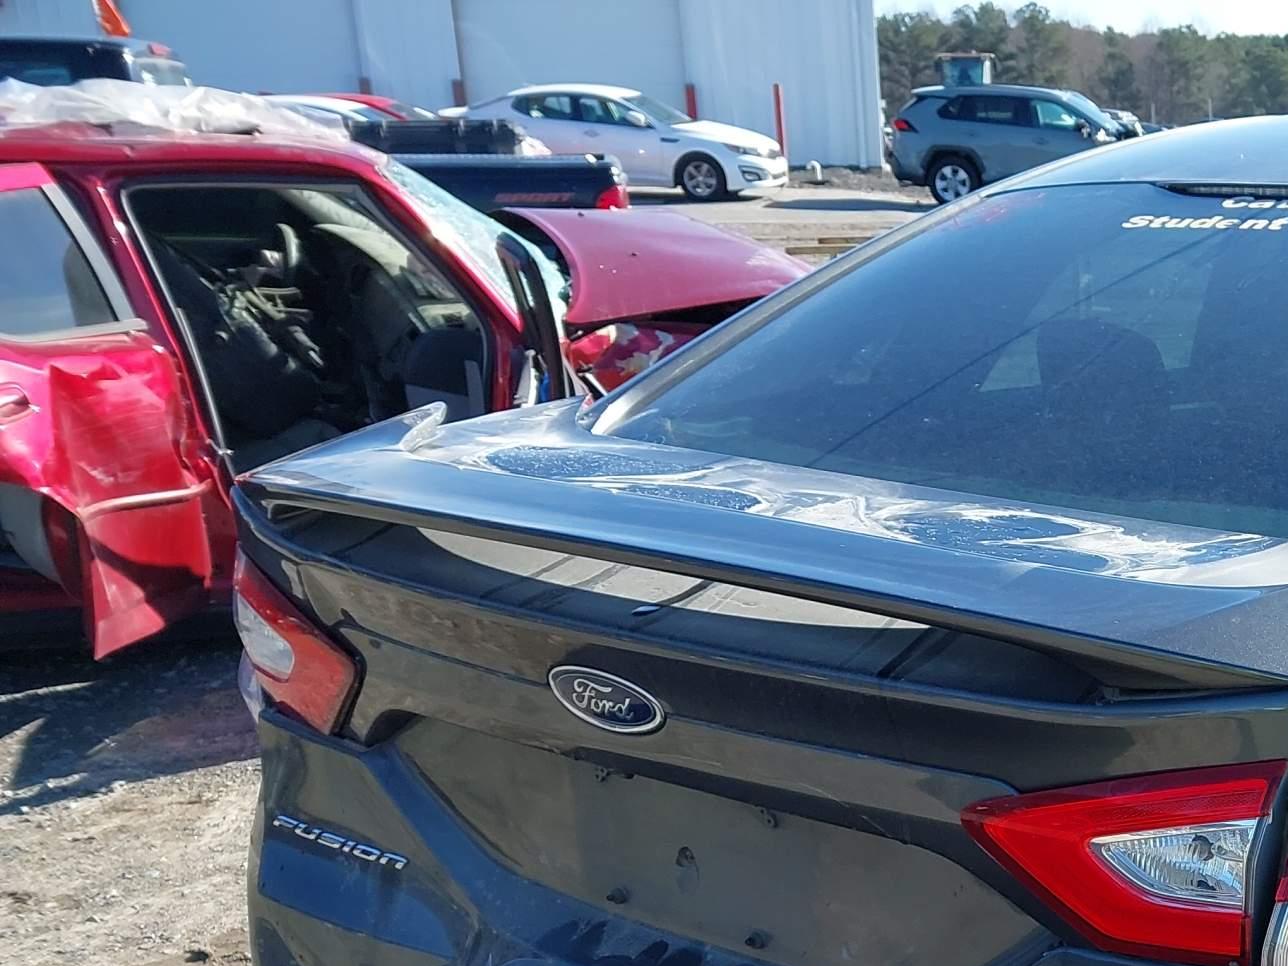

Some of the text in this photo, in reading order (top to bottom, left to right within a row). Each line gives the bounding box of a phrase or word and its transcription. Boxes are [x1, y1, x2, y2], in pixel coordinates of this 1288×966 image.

[1121, 214, 1288, 231] Student
[572, 678, 634, 720] Ford
[272, 815, 408, 870] FUSION
